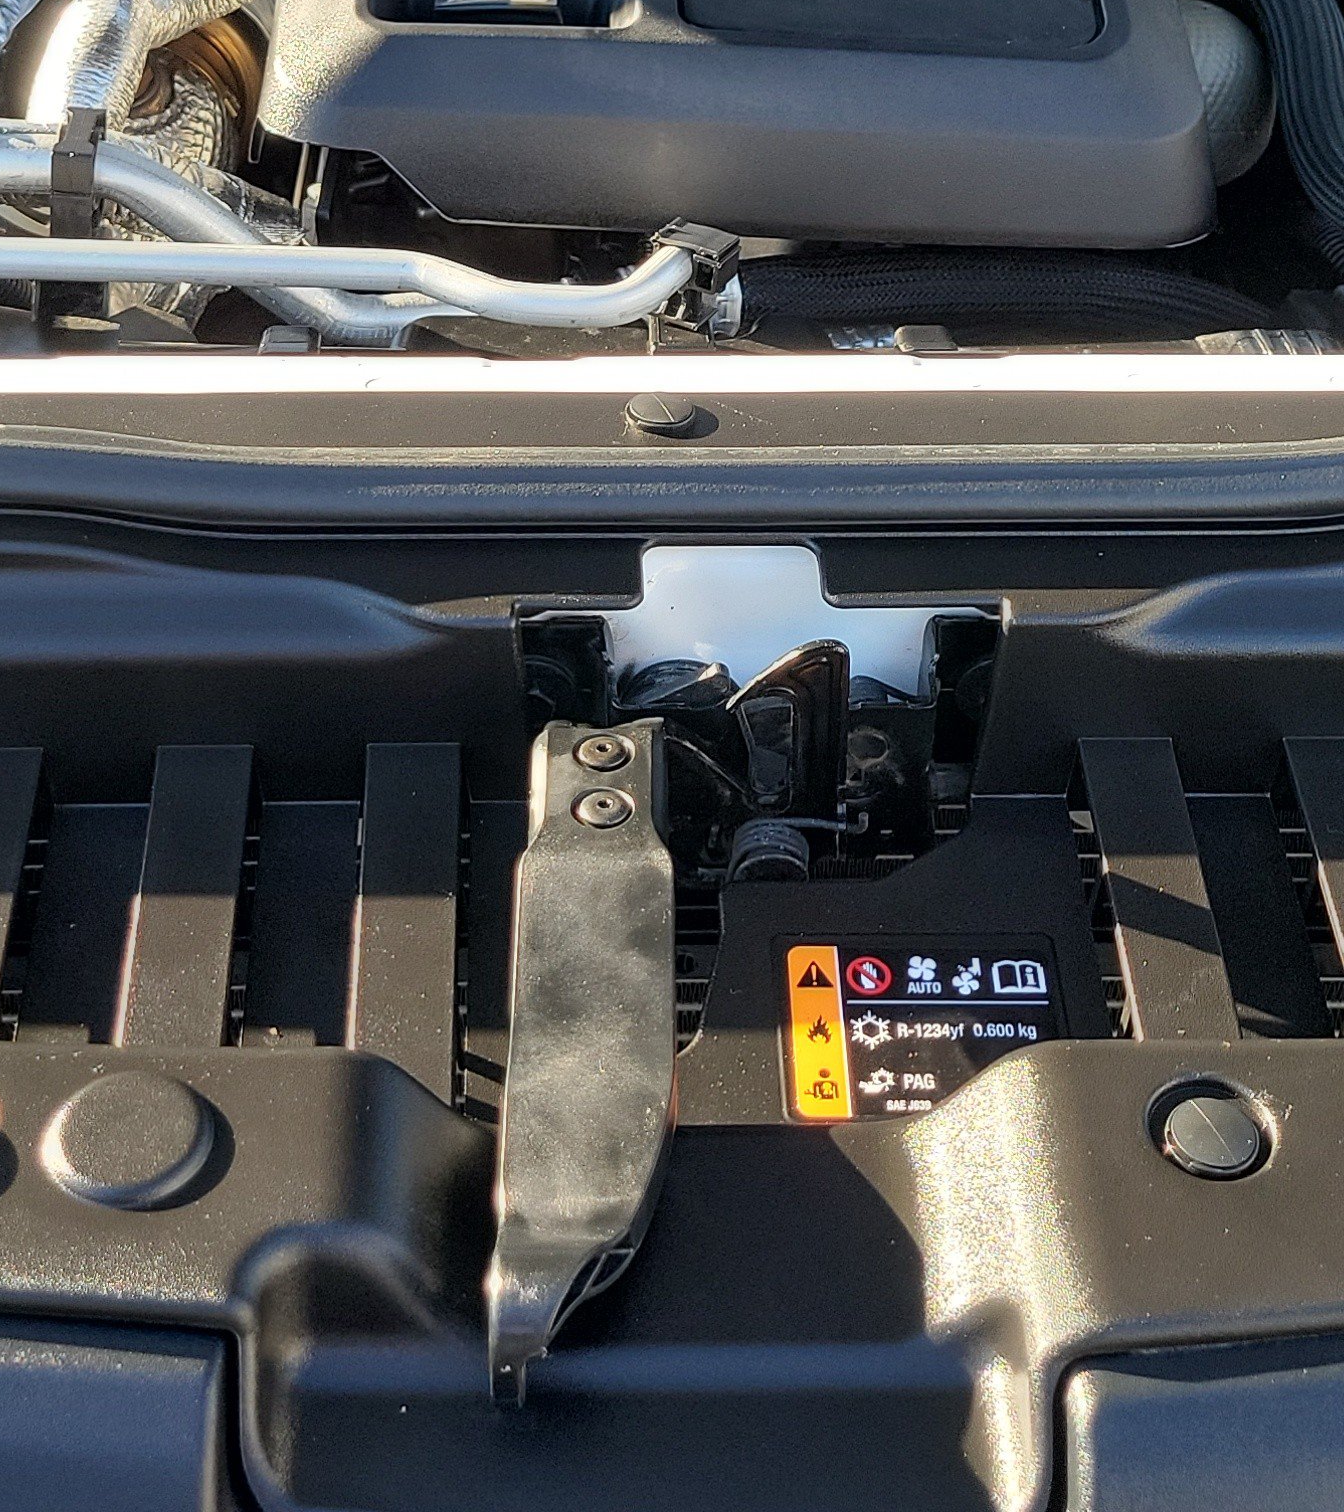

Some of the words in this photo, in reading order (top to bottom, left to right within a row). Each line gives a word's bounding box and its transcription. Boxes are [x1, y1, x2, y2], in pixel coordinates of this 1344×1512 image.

[907, 981, 941, 994] AUTO
[896, 1022, 964, 1041] R-1234yf
[973, 1023, 1014, 1038] 0.600
[1018, 1022, 1038, 1039] kg
[903, 1073, 936, 1090] PAG
[886, 1099, 907, 1111] SAE
